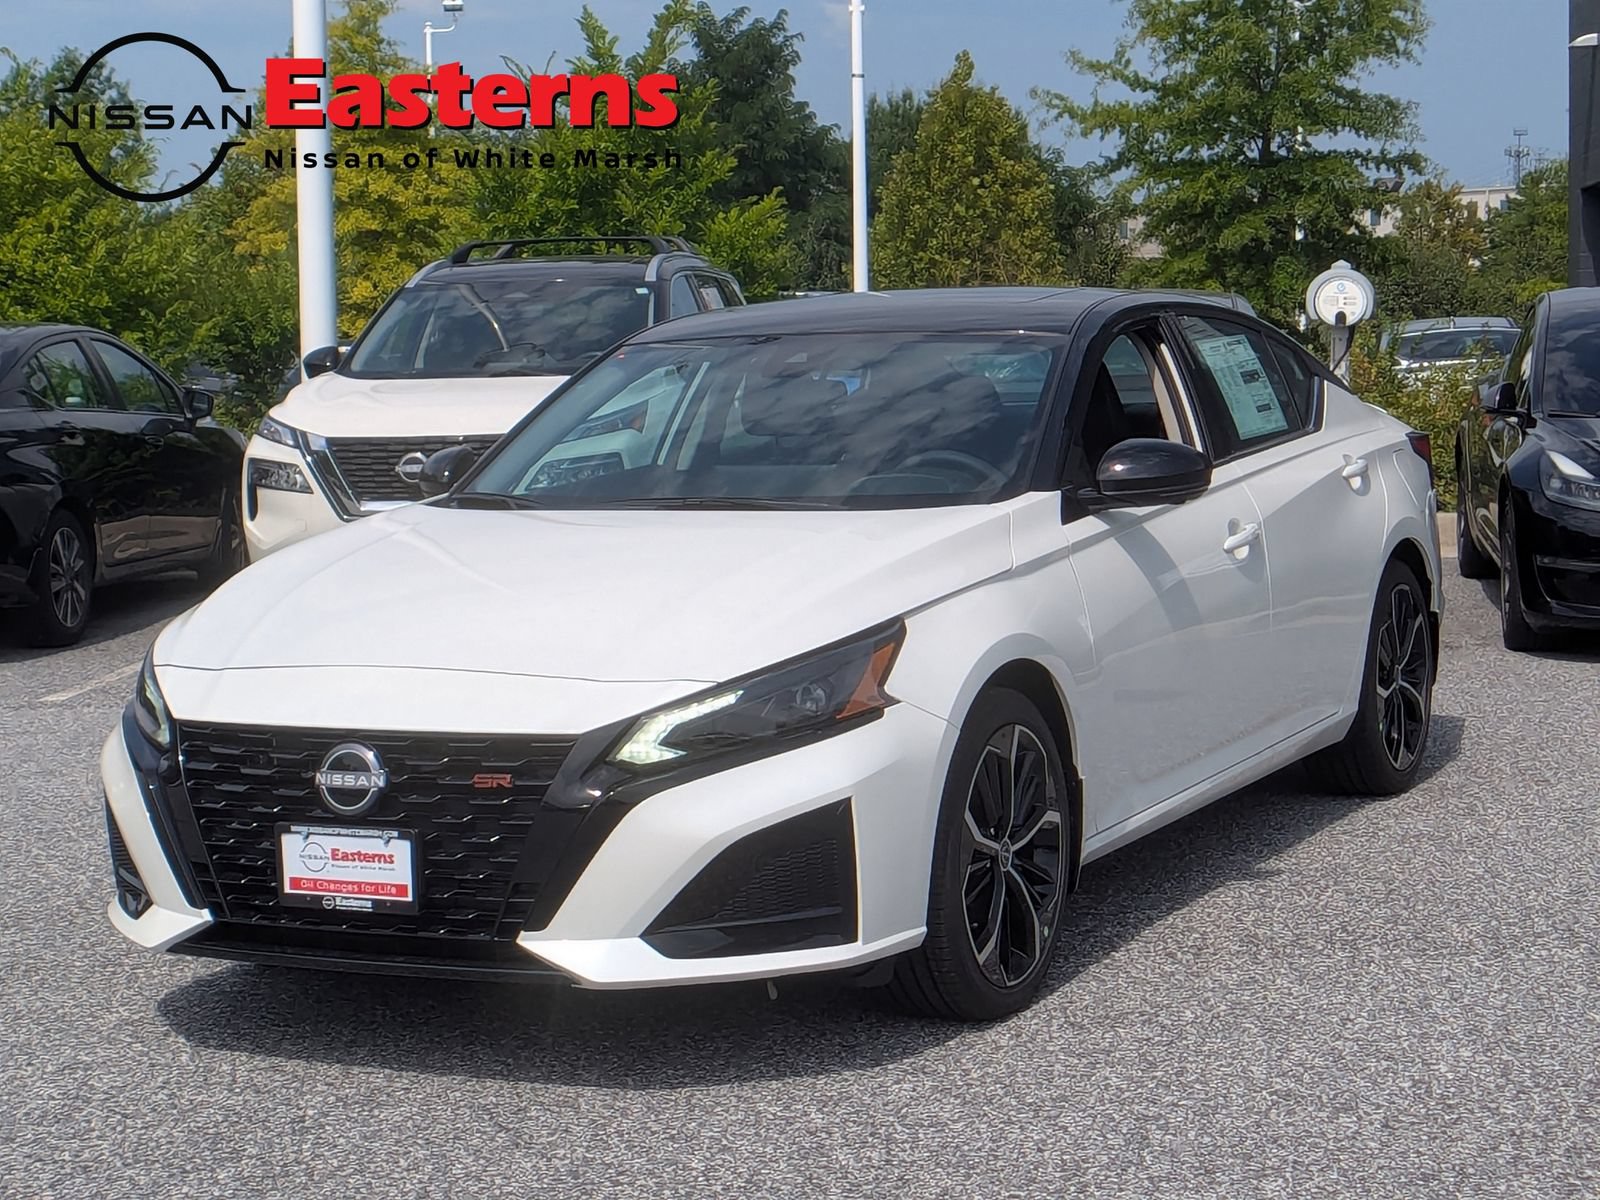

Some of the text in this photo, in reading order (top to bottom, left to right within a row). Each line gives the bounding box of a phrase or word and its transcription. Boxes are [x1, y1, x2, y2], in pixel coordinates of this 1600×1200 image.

[315, 772, 385, 788] NISSAN
[471, 773, 513, 788] SR
[331, 847, 395, 865] Easterns
[300, 879, 397, 894] Oil Changes for Life
